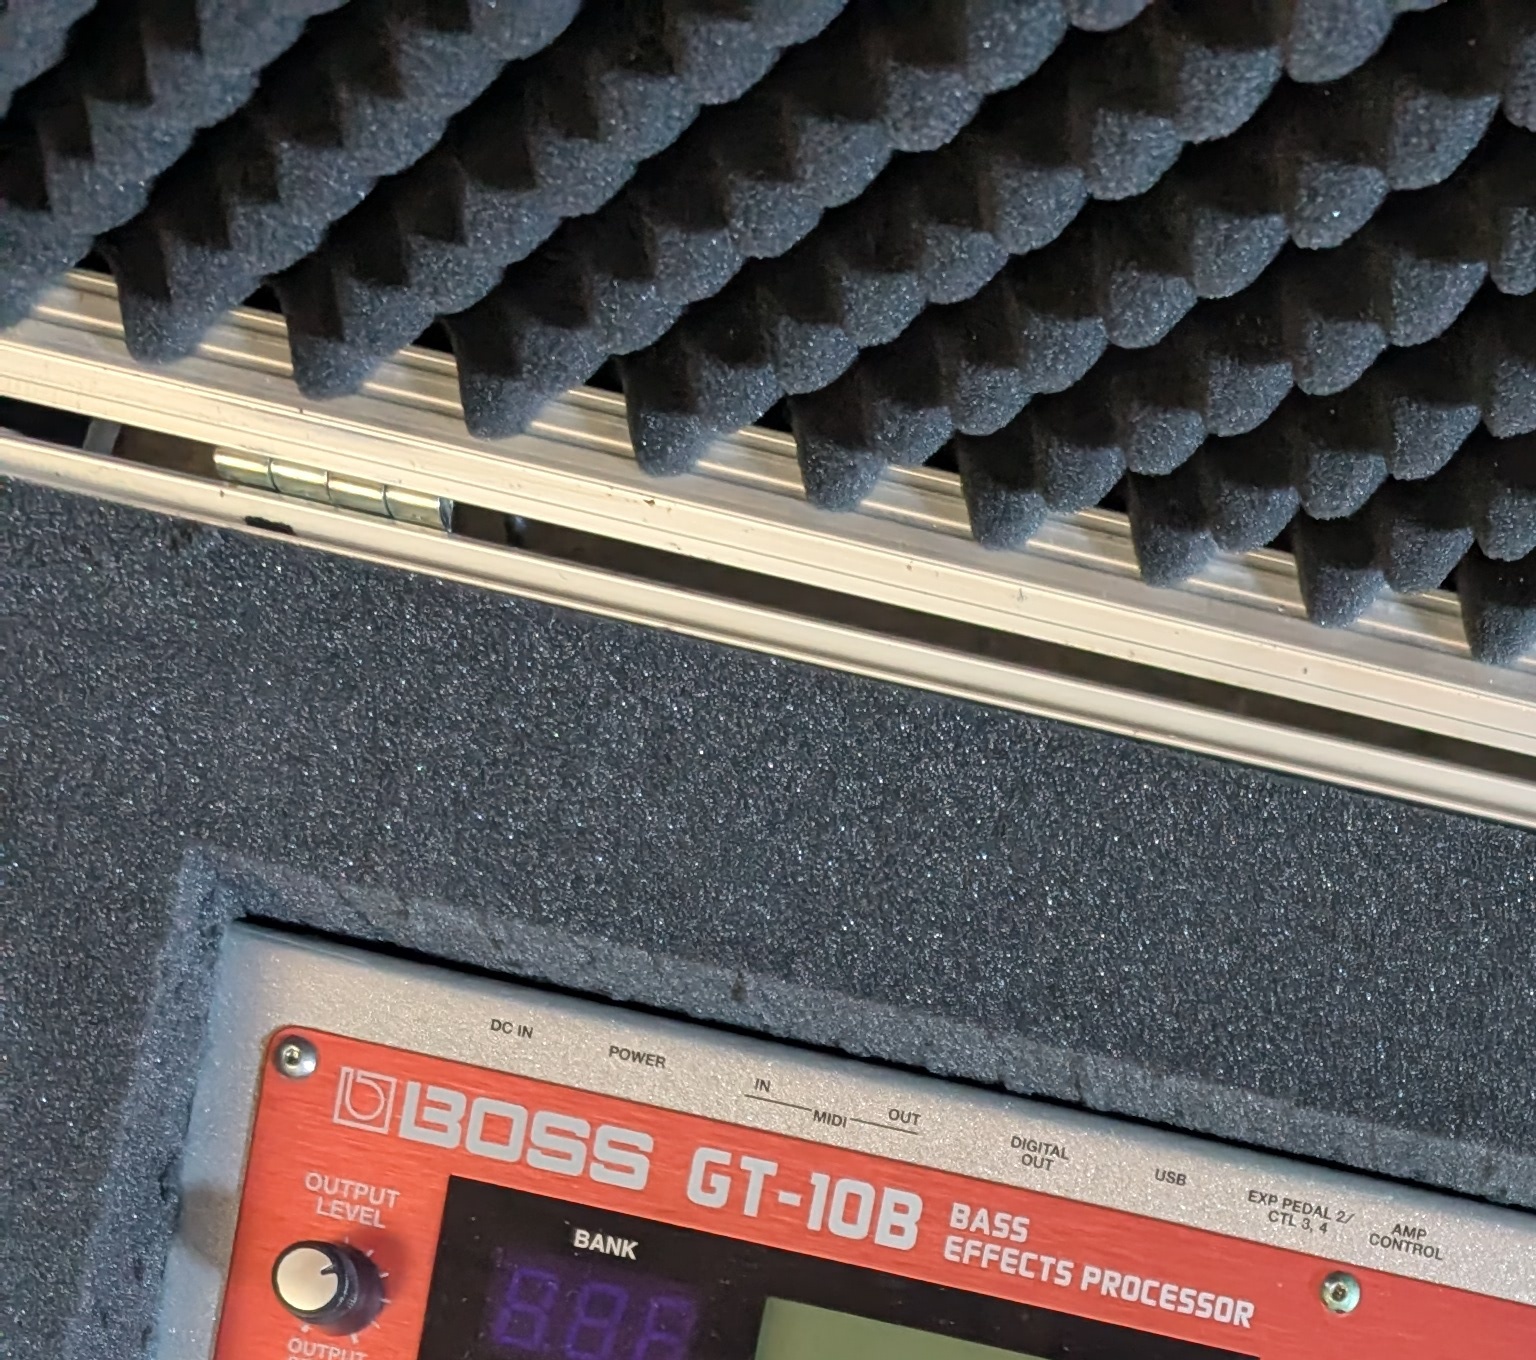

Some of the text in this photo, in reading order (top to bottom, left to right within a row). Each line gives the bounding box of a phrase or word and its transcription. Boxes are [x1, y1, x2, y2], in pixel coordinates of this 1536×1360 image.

[491, 1018, 534, 1039] DC IN
[609, 1045, 666, 1069] POWER
[755, 1078, 771, 1093] IN
[812, 1110, 848, 1128] MIDI
[888, 1108, 921, 1127] OUT
[1011, 1135, 1070, 1161] DIGITAL
[399, 1082, 923, 1251] BOSS GT-10B
[1021, 1152, 1054, 1172] OUT
[1155, 1168, 1187, 1187] USB
[305, 1172, 401, 1209] OUTPUT
[315, 1198, 387, 1229] LEVEL
[1248, 1190, 1354, 1225] EXP PEDAL 2/
[949, 1203, 1030, 1243] BASS
[1268, 1210, 1328, 1234] CTL 3, 4
[1391, 1224, 1427, 1240] AMP
[574, 1228, 639, 1261] BANK
[1369, 1232, 1444, 1261] CONTROL
[944, 1237, 1255, 1329] EFFECTS PROCESSOR
